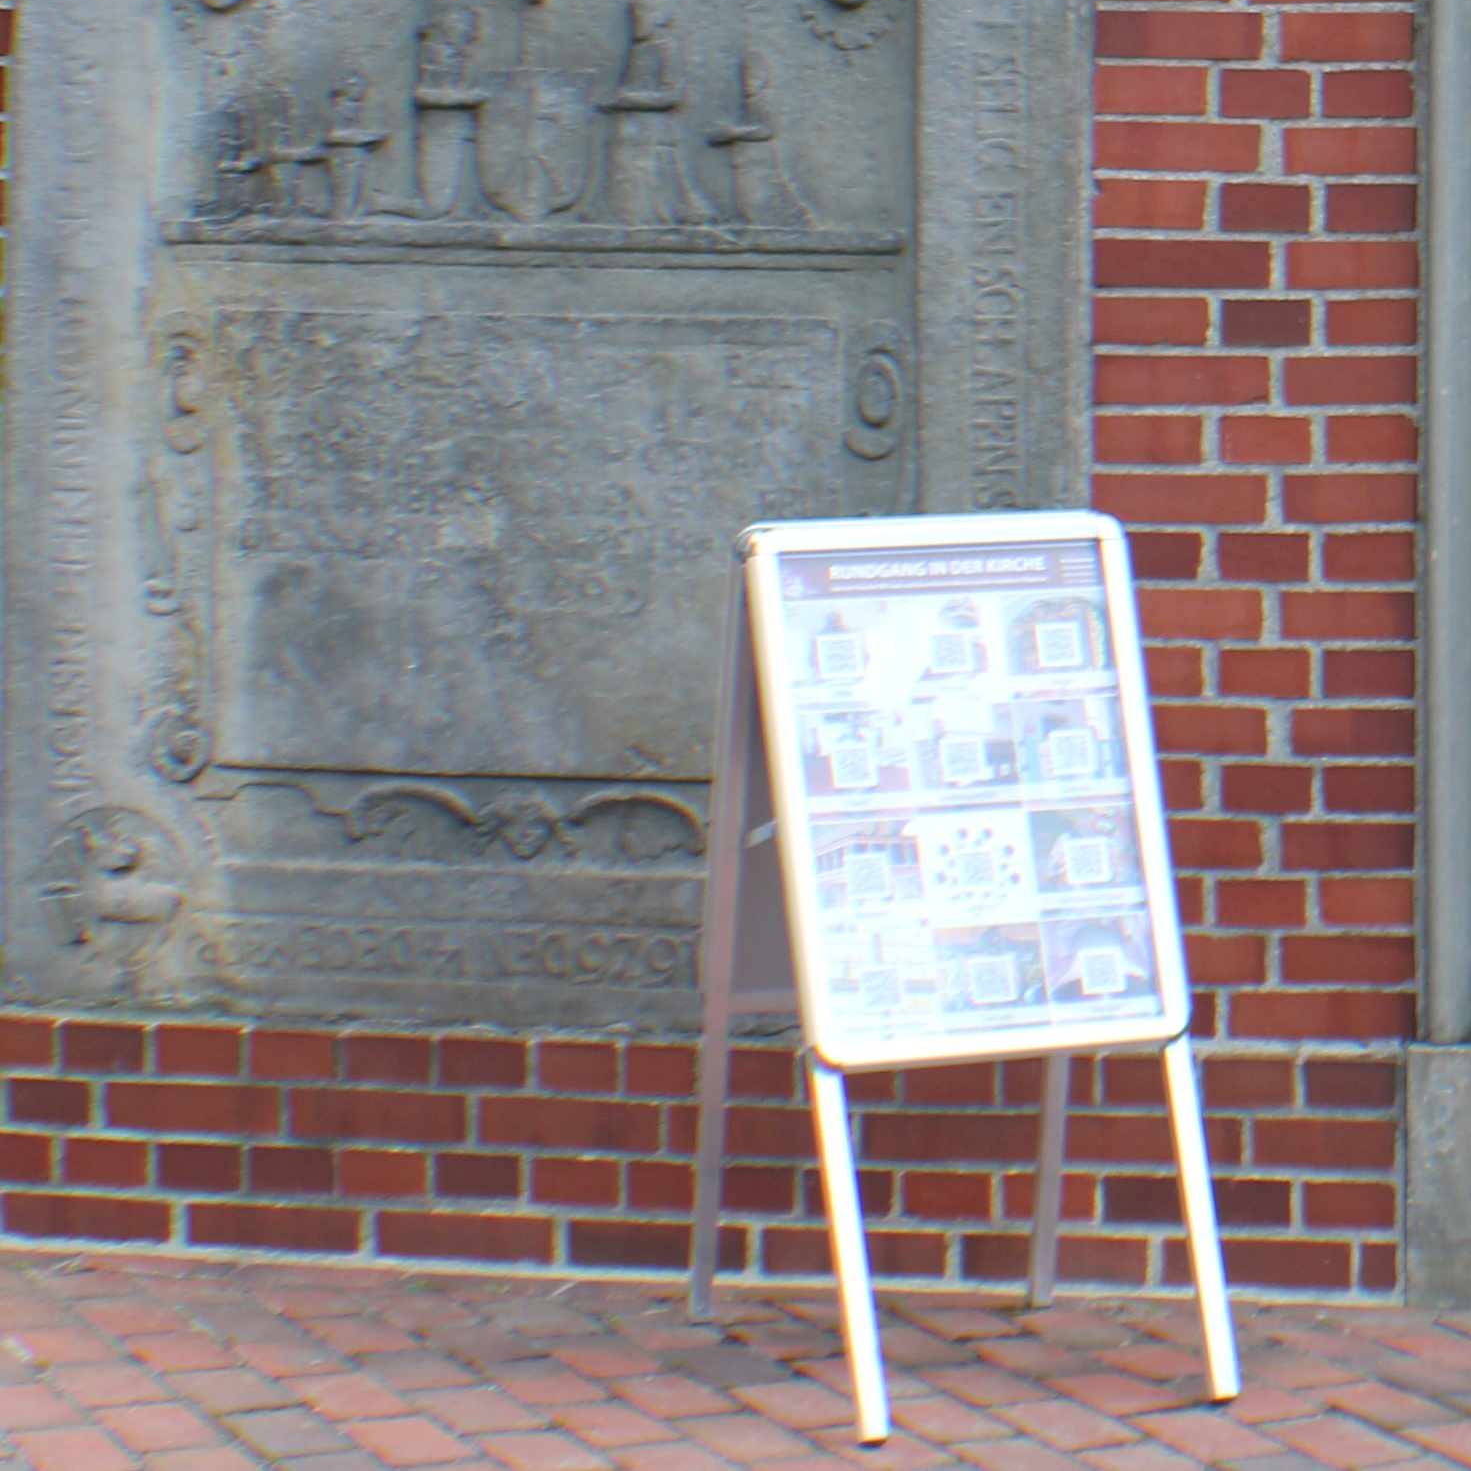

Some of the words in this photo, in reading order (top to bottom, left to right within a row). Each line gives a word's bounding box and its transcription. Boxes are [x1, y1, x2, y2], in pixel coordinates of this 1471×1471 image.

[827, 559, 926, 581] RUNDGANG
[928, 558, 947, 577] IN
[949, 557, 984, 576] DER
[986, 555, 1047, 574] KIRCHE
